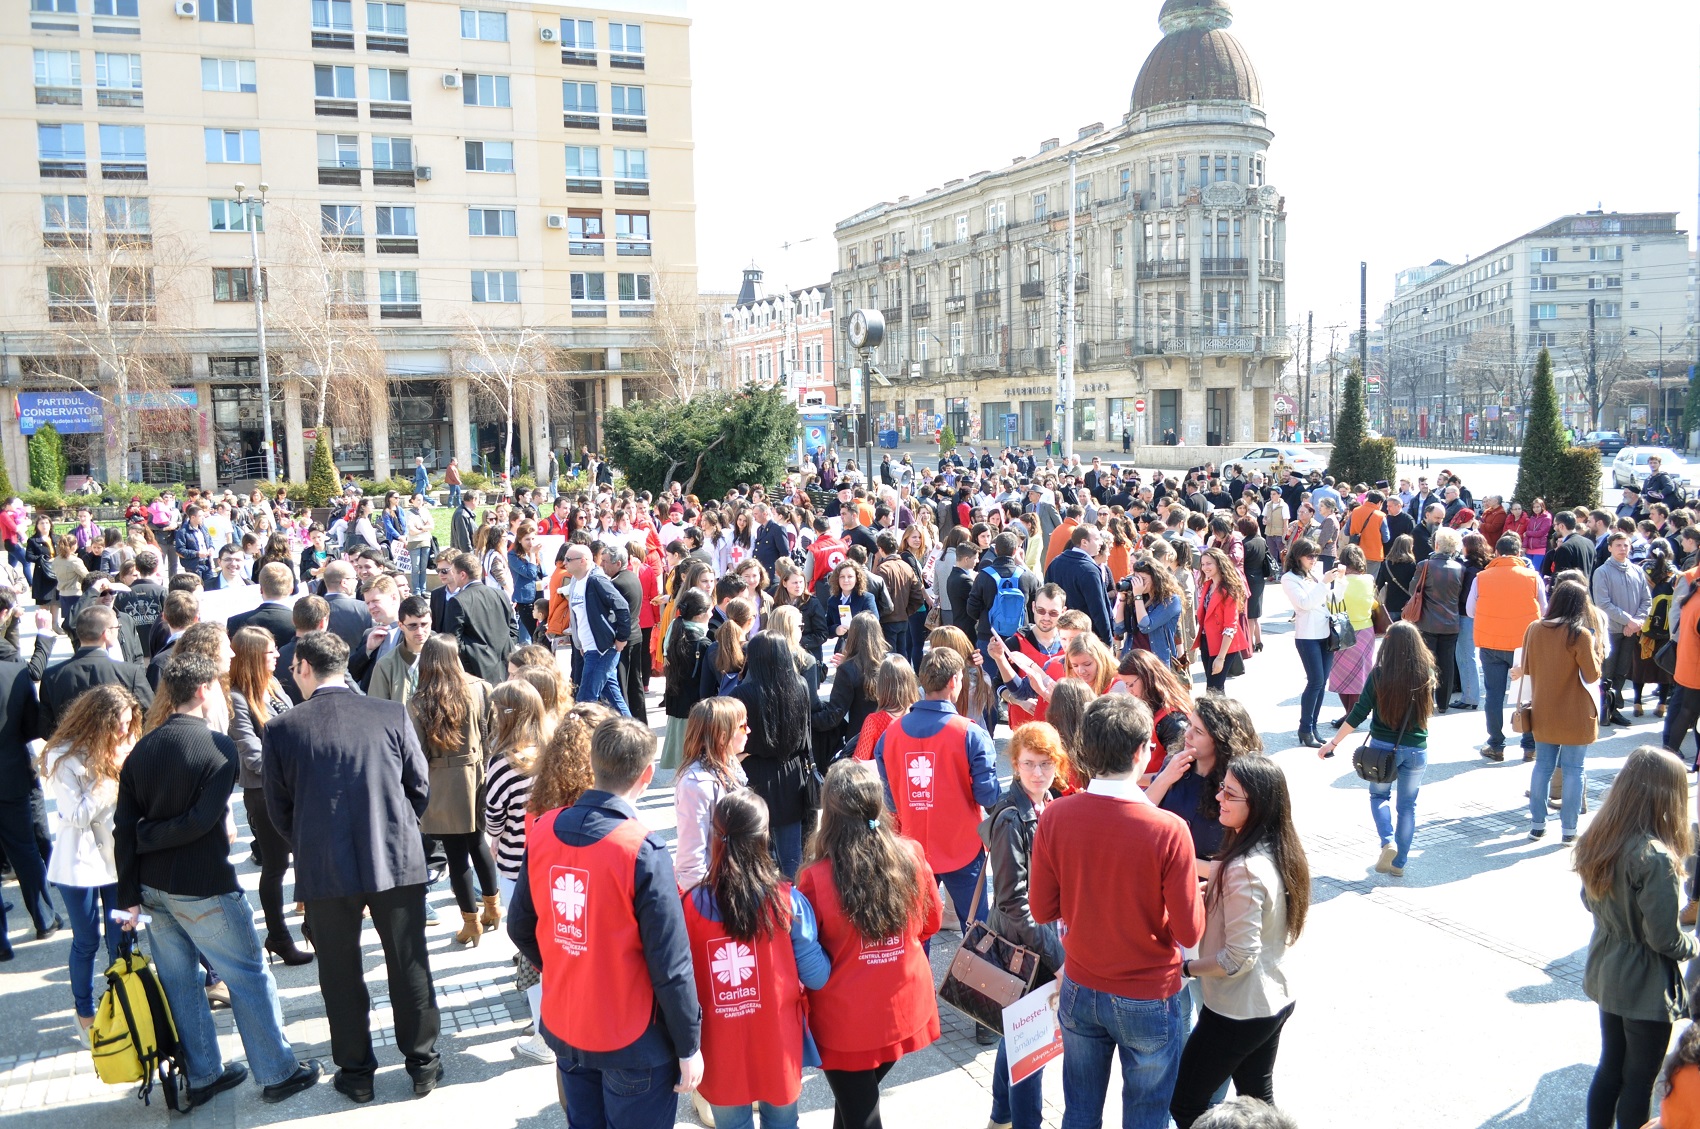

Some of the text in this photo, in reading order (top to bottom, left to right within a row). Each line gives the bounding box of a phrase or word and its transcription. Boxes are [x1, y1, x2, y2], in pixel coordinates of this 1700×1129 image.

[37, 397, 84, 406] PARTIDUL
[23, 407, 99, 416] CONSERVATOR
[881, 949, 905, 958] DIECEZAN
[719, 987, 756, 1000] caritas
[715, 1003, 762, 1014] CENTRUL DIECEZAN
[1013, 1031, 1025, 1045] pe
